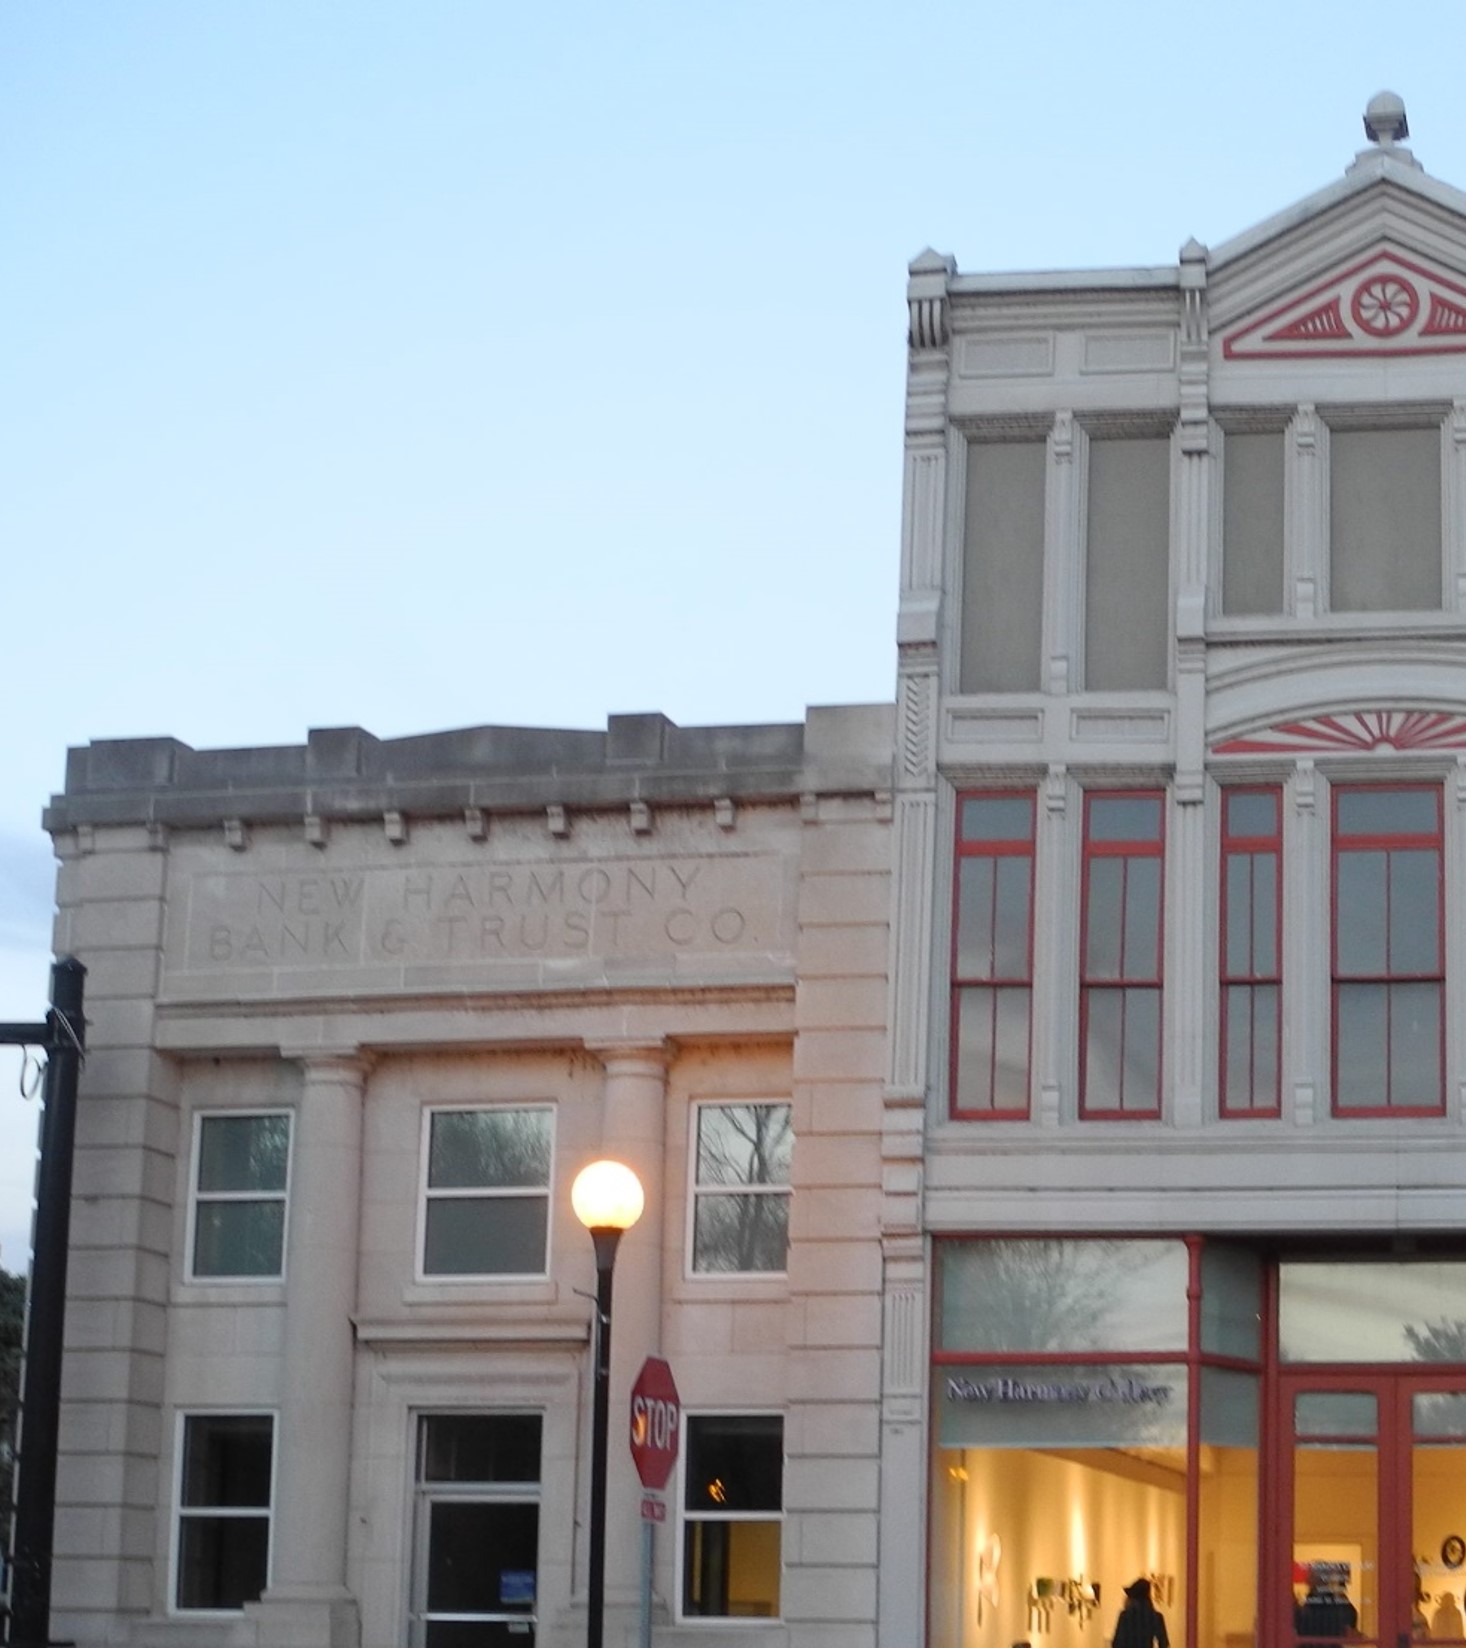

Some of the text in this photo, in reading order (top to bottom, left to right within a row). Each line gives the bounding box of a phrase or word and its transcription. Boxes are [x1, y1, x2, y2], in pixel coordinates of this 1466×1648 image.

[256, 865, 700, 915] NEW HARMONY
[209, 922, 350, 961] BANK
[381, 917, 409, 954] &
[434, 909, 632, 952] TRUST
[947, 1377, 990, 1402] New
[997, 1377, 1090, 1405] Harmony
[631, 1395, 678, 1452] STOP
